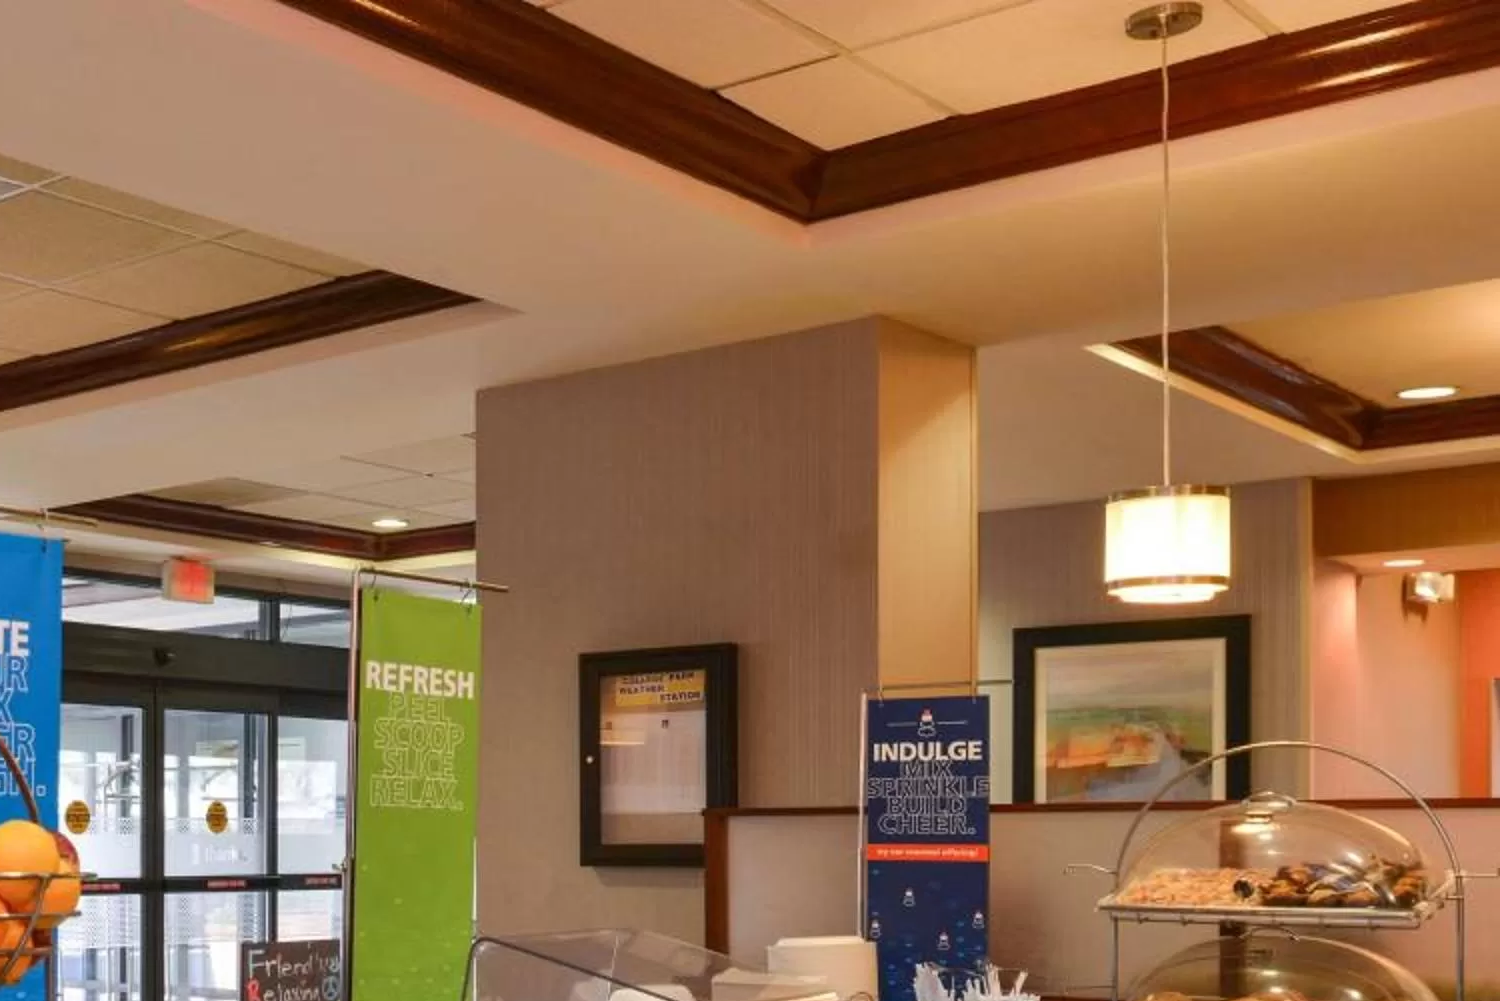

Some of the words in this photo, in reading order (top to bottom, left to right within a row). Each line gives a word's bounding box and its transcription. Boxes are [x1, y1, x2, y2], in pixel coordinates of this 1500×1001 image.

[365, 660, 475, 699] REFRESH
[388, 688, 452, 724] PEEL
[373, 716, 465, 756] SCOOP
[873, 740, 983, 763] INDULGE
[382, 746, 456, 784] SLICE
[900, 758, 954, 780] MIX
[868, 775, 990, 799] SPRINKLE
[887, 796, 967, 817] BUILD
[877, 813, 977, 835] CHEER.
